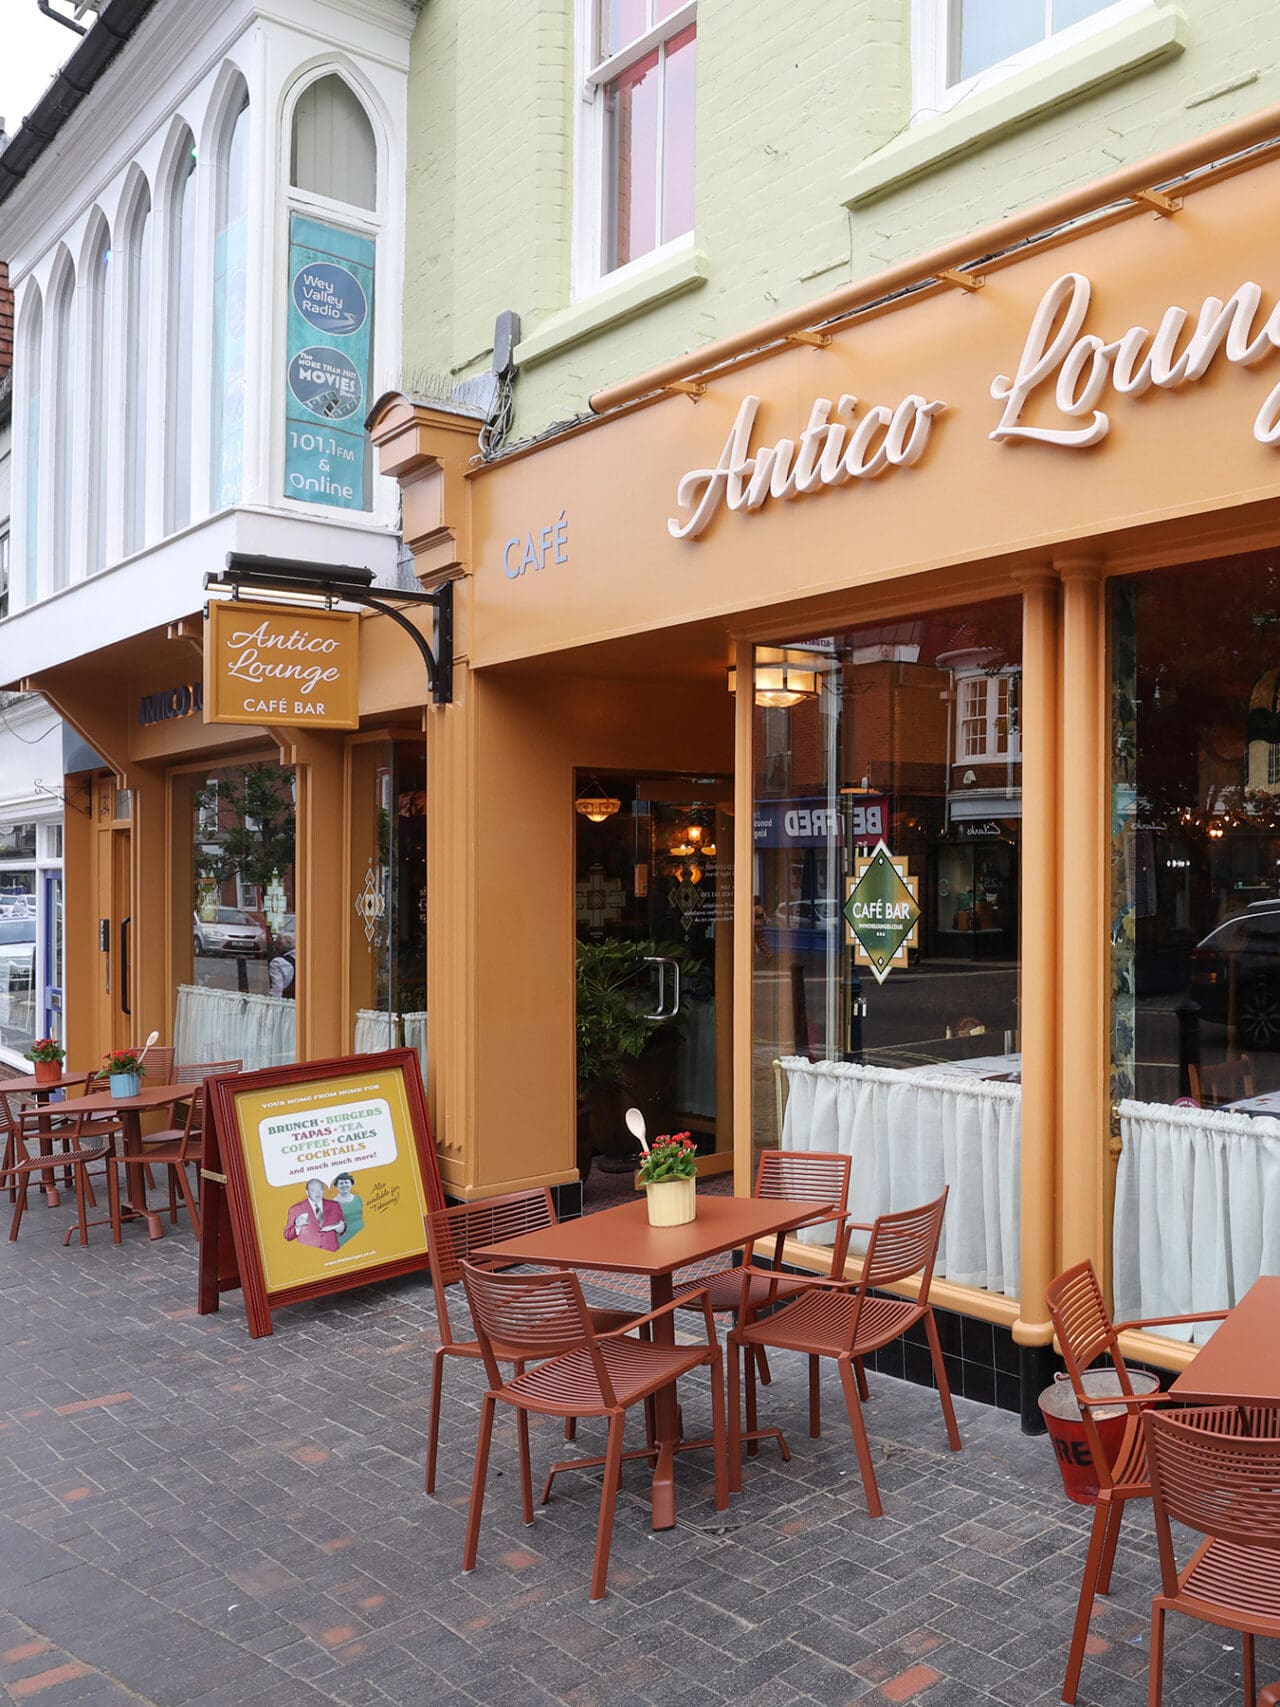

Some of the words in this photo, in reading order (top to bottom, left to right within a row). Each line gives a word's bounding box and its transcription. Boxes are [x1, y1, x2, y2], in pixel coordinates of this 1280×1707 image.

[304, 274, 333, 294] Wey
[302, 287, 343, 309] Valley
[302, 300, 340, 318] Radio
[300, 352, 313, 360] The
[299, 359, 321, 369] MORE
[342, 369, 357, 379] JUST
[299, 367, 355, 393] MOVIES
[319, 458, 330, 472] &
[667, 395, 947, 539] Antico
[290, 473, 353, 499] Online
[503, 510, 568, 579] CAFÉ
[226, 621, 340, 653] Antico
[227, 648, 341, 694] Lounge
[243, 698, 287, 714] CAFÉ
[294, 702, 325, 715] BAR
[852, 898, 883, 919] CAFÉ
[885, 902, 910, 919] BAR
[260, 1101, 286, 1109] YOUR
[287, 1096, 312, 1105] HOME
[313, 1092, 337, 1100] FROM
[338, 1088, 363, 1096] HOME
[363, 1084, 380, 1093] FOR
[268, 1119, 319, 1134] BRUNCH
[325, 1107, 383, 1125] BURGERS
[291, 1127, 332, 1141] TAPAS
[339, 1121, 364, 1133] TEA
[281, 1138, 330, 1154] COFFEE
[337, 1129, 377, 1143] CAKES
[297, 1142, 366, 1162] COCKTAILS
[289, 1166, 304, 1176] and
[307, 1162, 329, 1171] much
[331, 1157, 353, 1167] much
[354, 1152, 377, 1162] more!
